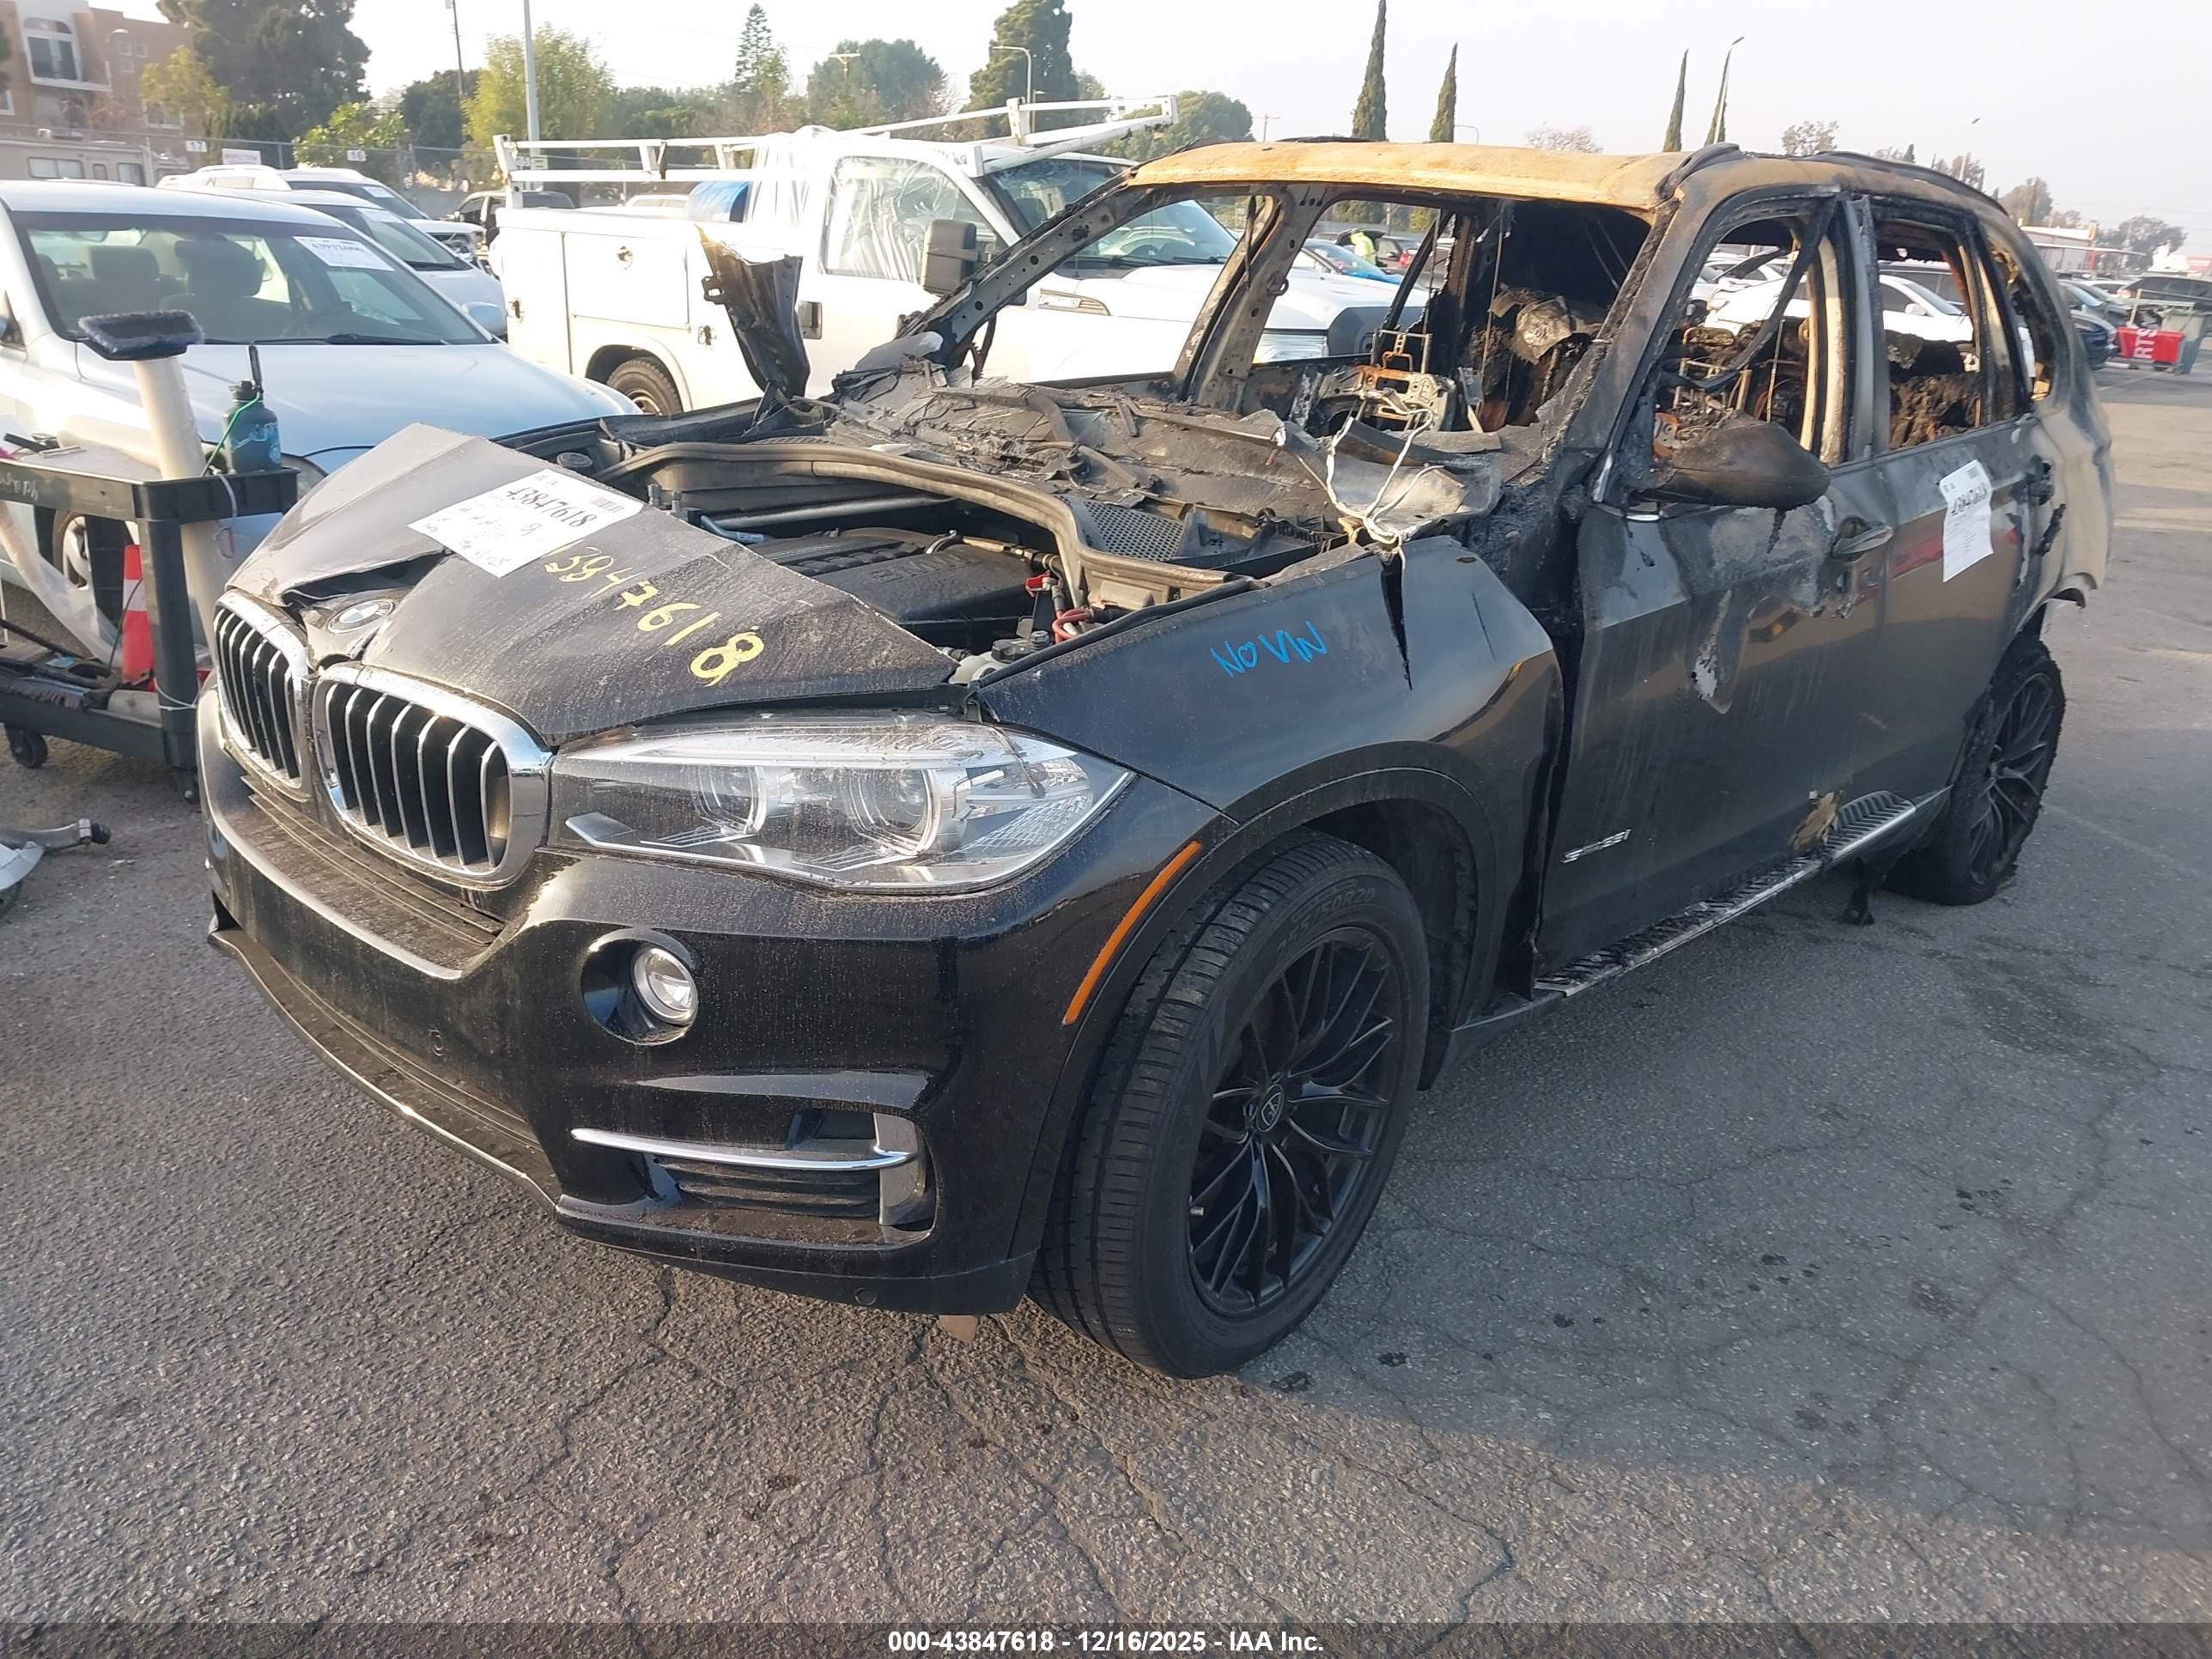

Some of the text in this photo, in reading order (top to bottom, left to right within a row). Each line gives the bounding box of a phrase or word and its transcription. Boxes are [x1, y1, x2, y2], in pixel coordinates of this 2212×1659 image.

[505, 485, 599, 529] 43847618
[1209, 619, 1328, 678] NO VIN
